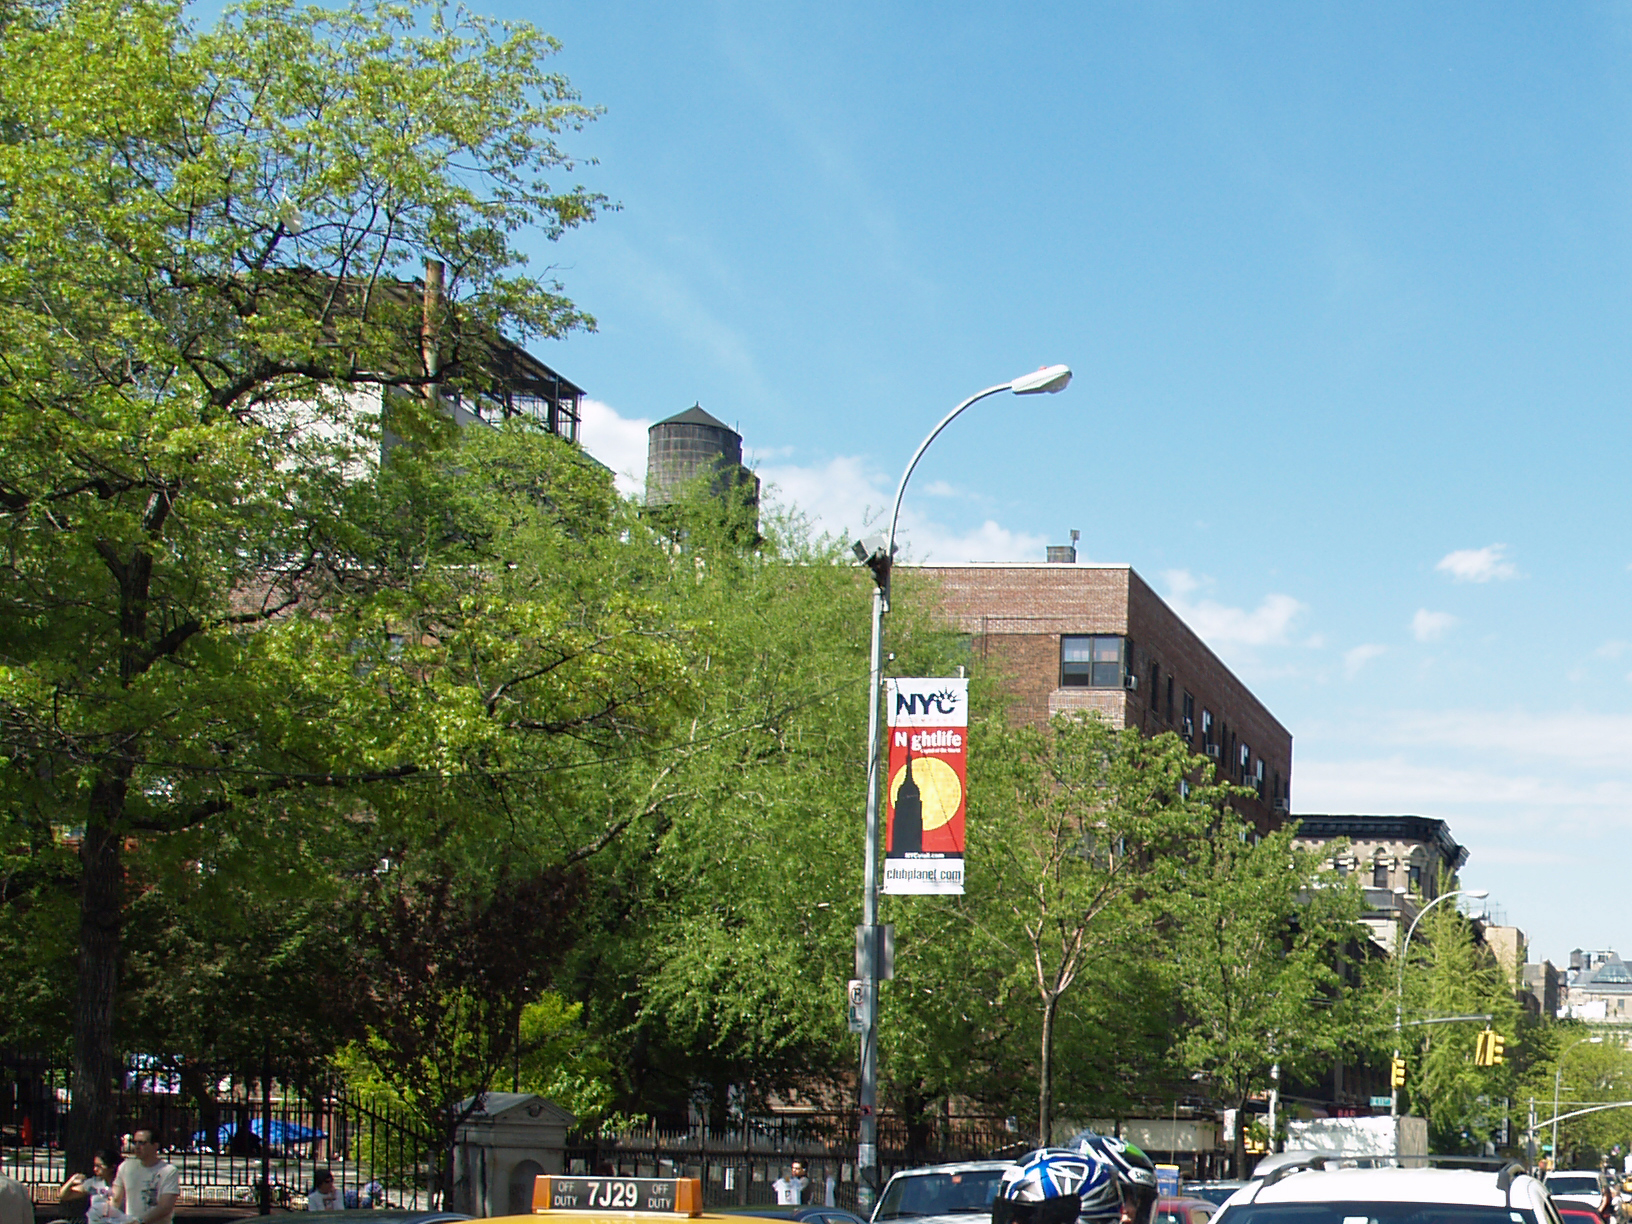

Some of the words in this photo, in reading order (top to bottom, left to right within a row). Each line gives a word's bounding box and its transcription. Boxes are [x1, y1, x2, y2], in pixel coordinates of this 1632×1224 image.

[896, 688, 957, 715] NYC
[553, 1195, 577, 1207] DUTY
[647, 1197, 671, 1209] DUTY
[558, 1181, 575, 1193] OFF
[587, 1181, 639, 1207] 7J29
[651, 1183, 669, 1195] OFF
